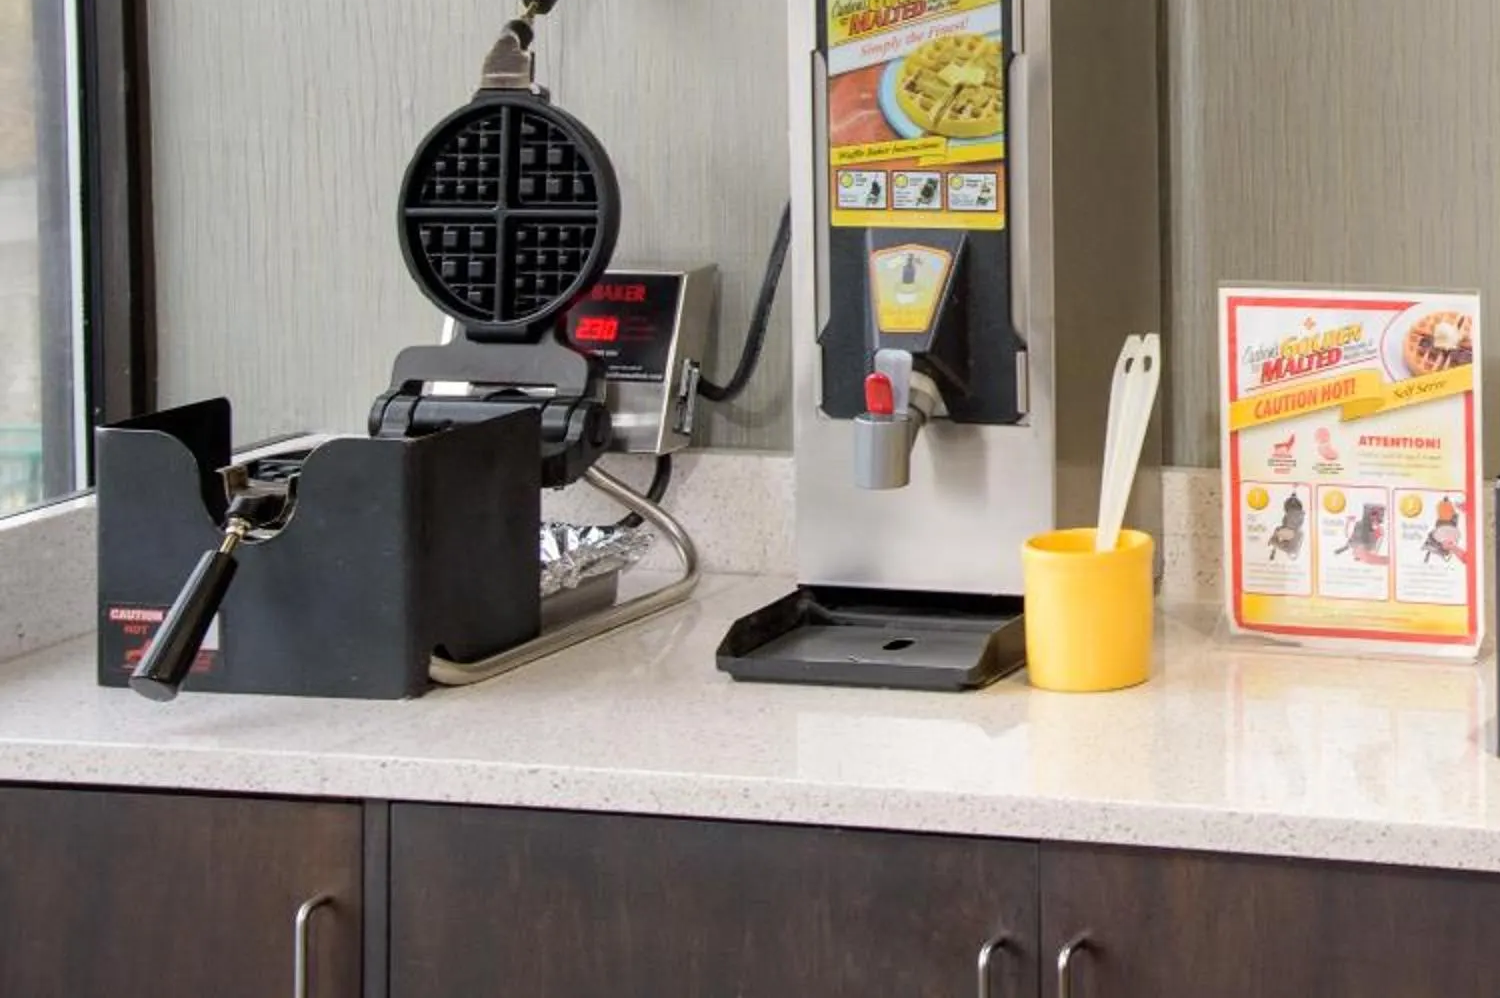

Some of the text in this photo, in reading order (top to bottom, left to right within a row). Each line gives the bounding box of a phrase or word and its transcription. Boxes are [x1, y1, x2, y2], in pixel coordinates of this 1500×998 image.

[1260, 346, 1343, 384] MALTED
[1254, 377, 1356, 420] CAUTION HOT!
[1358, 435, 1441, 450] ATTENTION!
